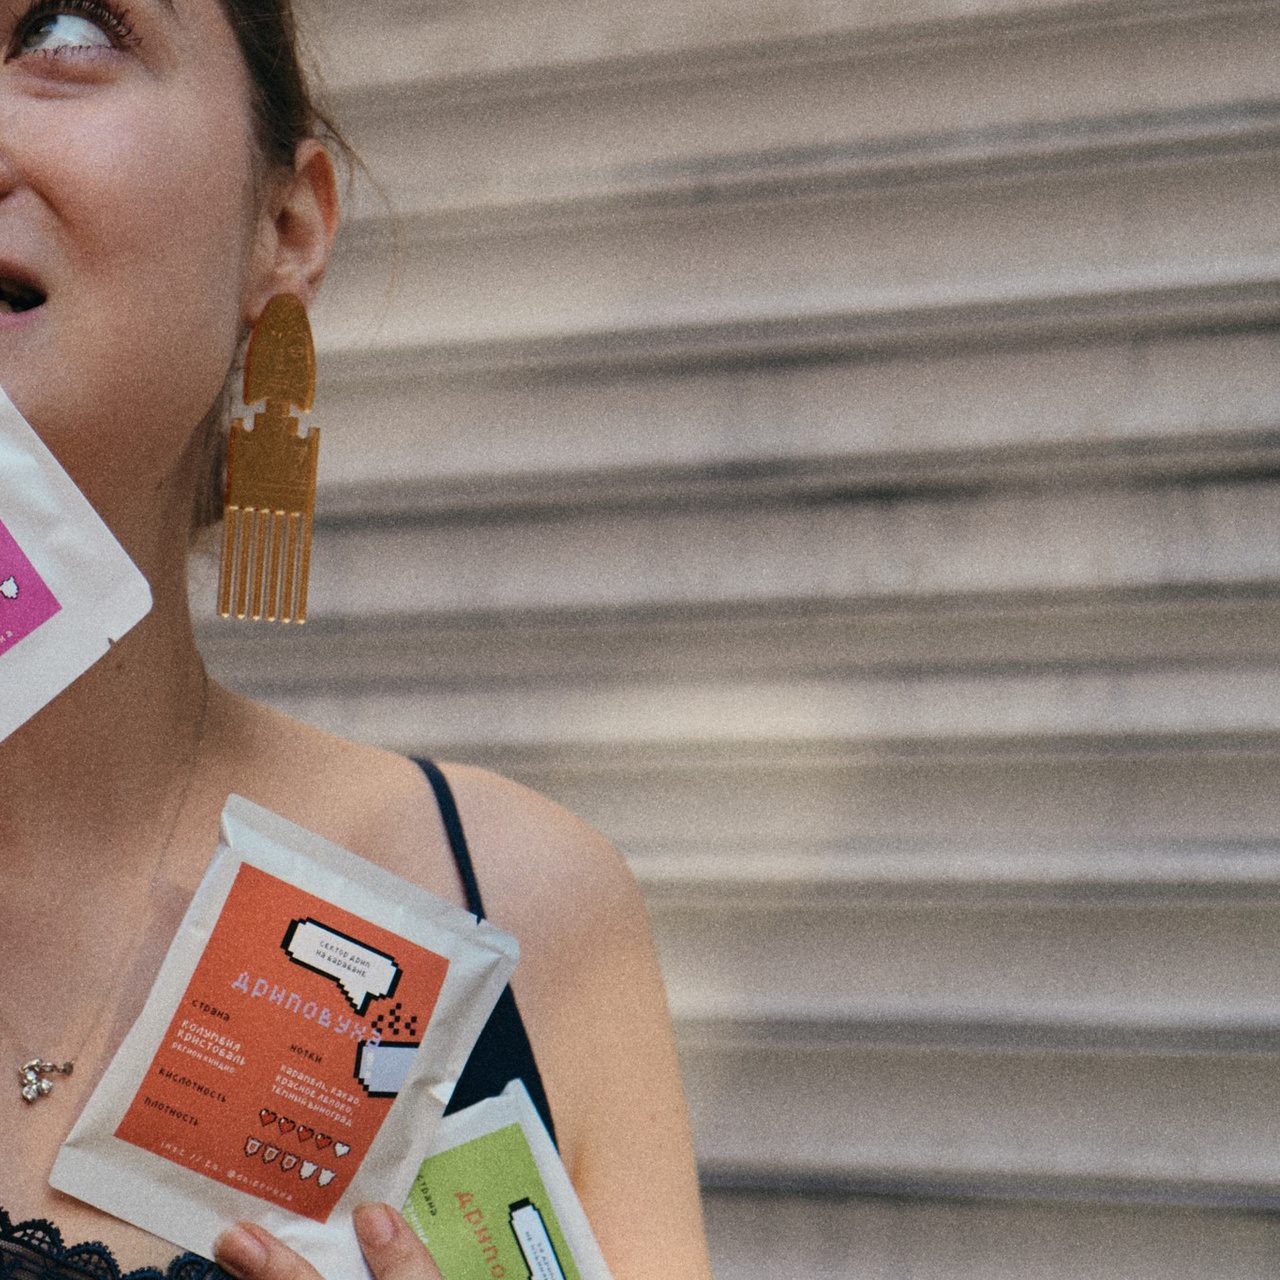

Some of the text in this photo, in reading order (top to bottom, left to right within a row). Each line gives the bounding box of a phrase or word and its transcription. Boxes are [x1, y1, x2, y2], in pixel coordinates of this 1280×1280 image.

[190, 998, 231, 1022] страна
[230, 968, 384, 1050] дриповуха
[180, 1019, 242, 1052] колумбия
[288, 1043, 323, 1064] нотки
[157, 1067, 228, 1103] кислотность
[143, 1096, 200, 1126] плотность
